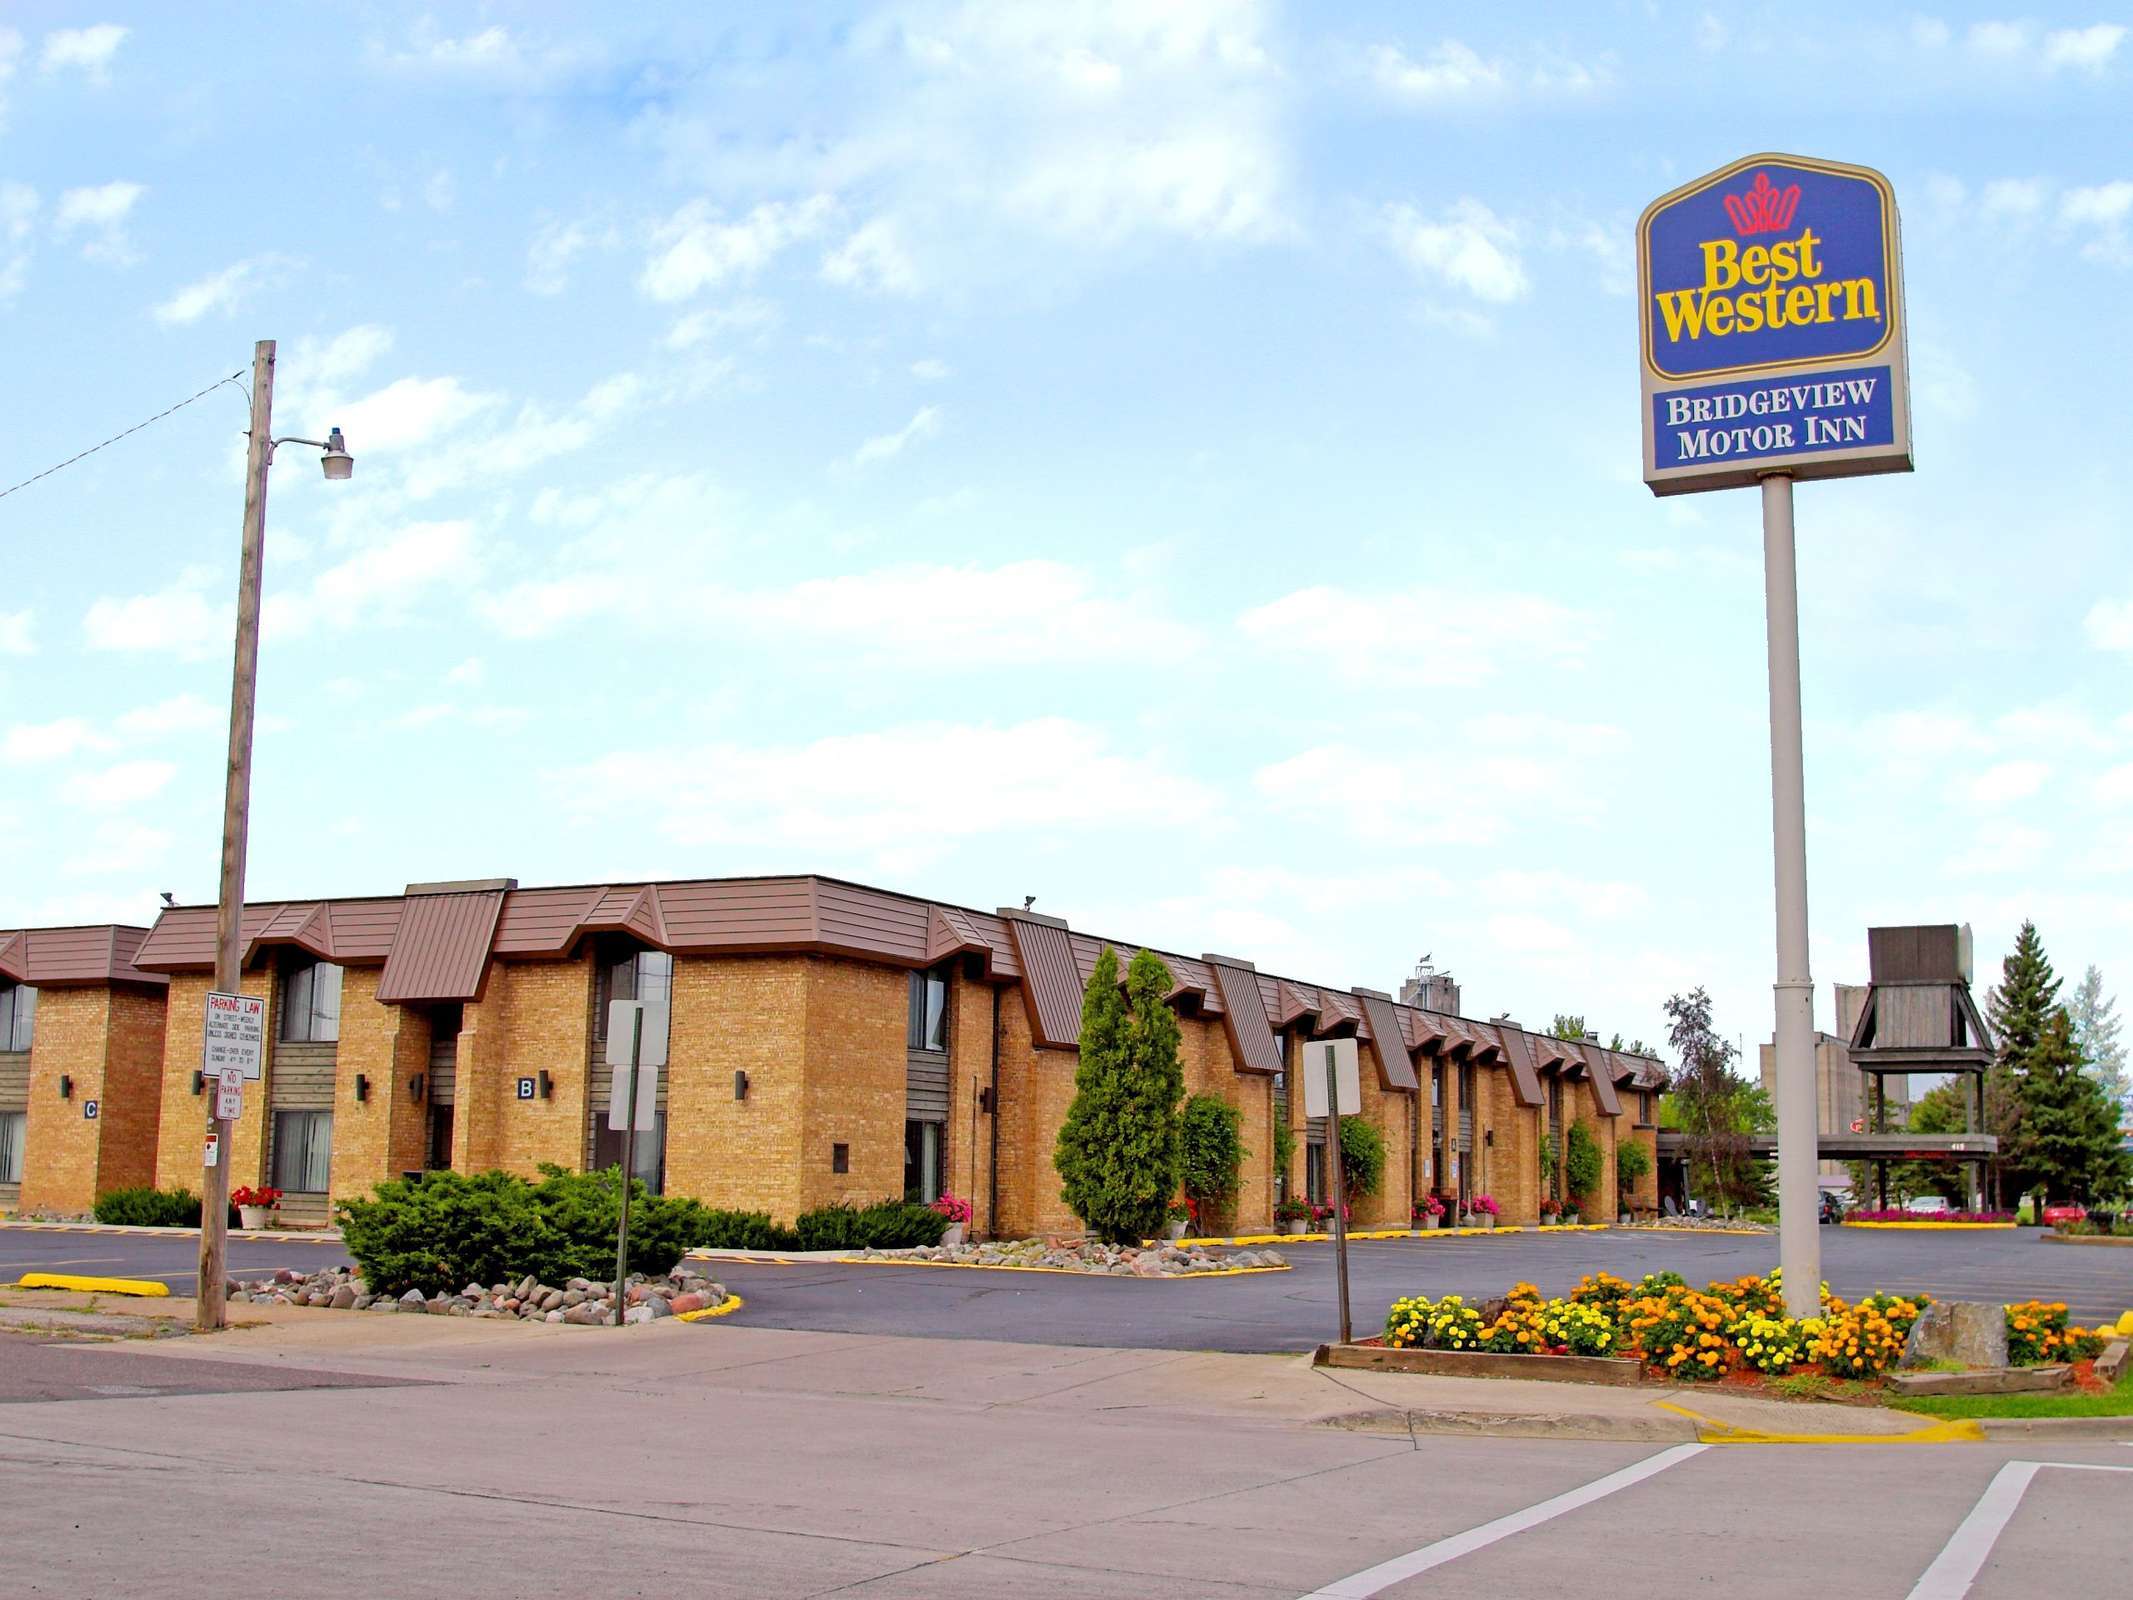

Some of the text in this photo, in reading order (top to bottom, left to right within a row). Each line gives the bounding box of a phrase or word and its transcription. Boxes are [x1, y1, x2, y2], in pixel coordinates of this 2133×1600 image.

[1699, 227, 1822, 291] Best
[1655, 268, 1881, 343] Western
[1666, 378, 1877, 426] BRIDGEVIEW
[1677, 415, 1867, 460] MOTOR INN
[210, 997, 260, 1015] PARKING LAW
[244, 1025, 260, 1033] PARKING
[211, 1054, 226, 1062] SUNDAY
[227, 1074, 236, 1083] NO
[221, 1085, 241, 1096] PARKING
[521, 1080, 532, 1097] B
[87, 1102, 96, 1117] C
[224, 1106, 236, 1114] TIME
